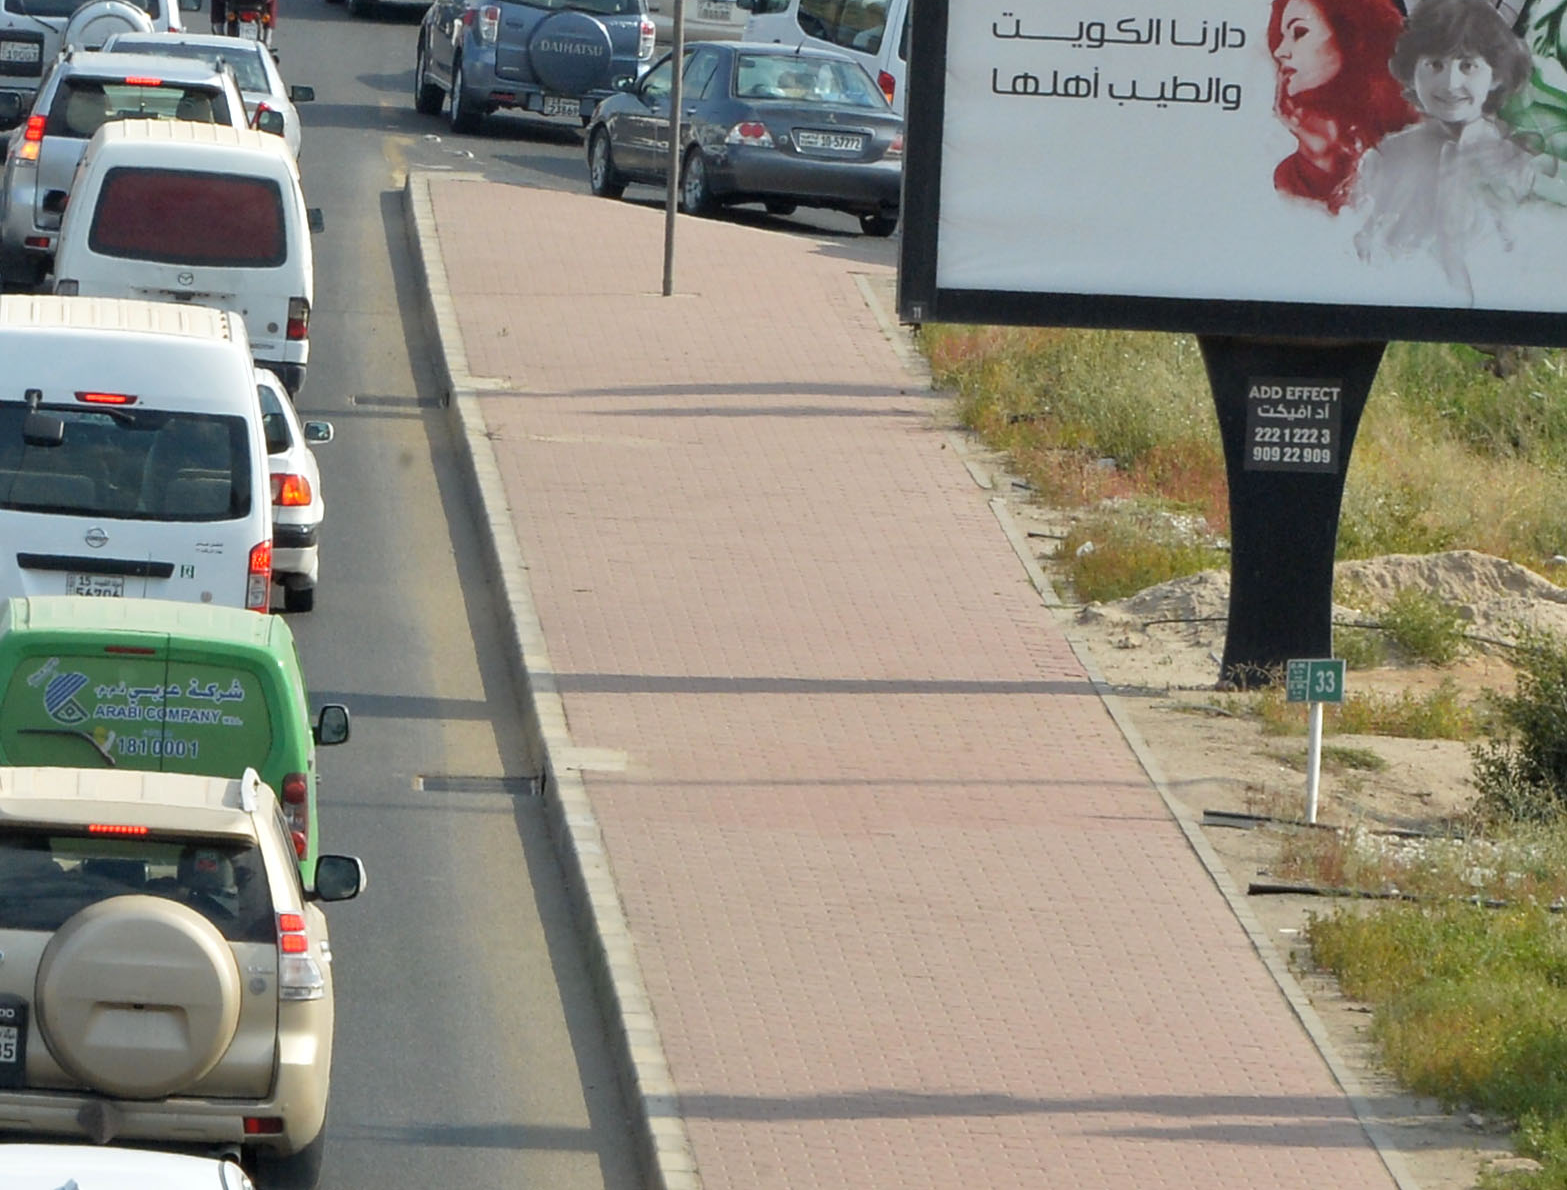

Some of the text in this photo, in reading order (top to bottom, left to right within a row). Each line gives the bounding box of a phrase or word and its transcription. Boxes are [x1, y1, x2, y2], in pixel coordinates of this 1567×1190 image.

[992, 12, 1246, 54] دارنا الكويت
[541, 40, 603, 57] DAIHATSU
[992, 66, 1242, 111] والطيب أهلها
[1249, 385, 1341, 401] ADD EFFECT
[1253, 447, 1331, 463] 909 22 909
[188, 678, 244, 704] شركة
[1315, 670, 1336, 693] 33
[128, 684, 182, 706] عربي
[93, 705, 142, 721] ARABI
[144, 706, 221, 725] COMPANY
